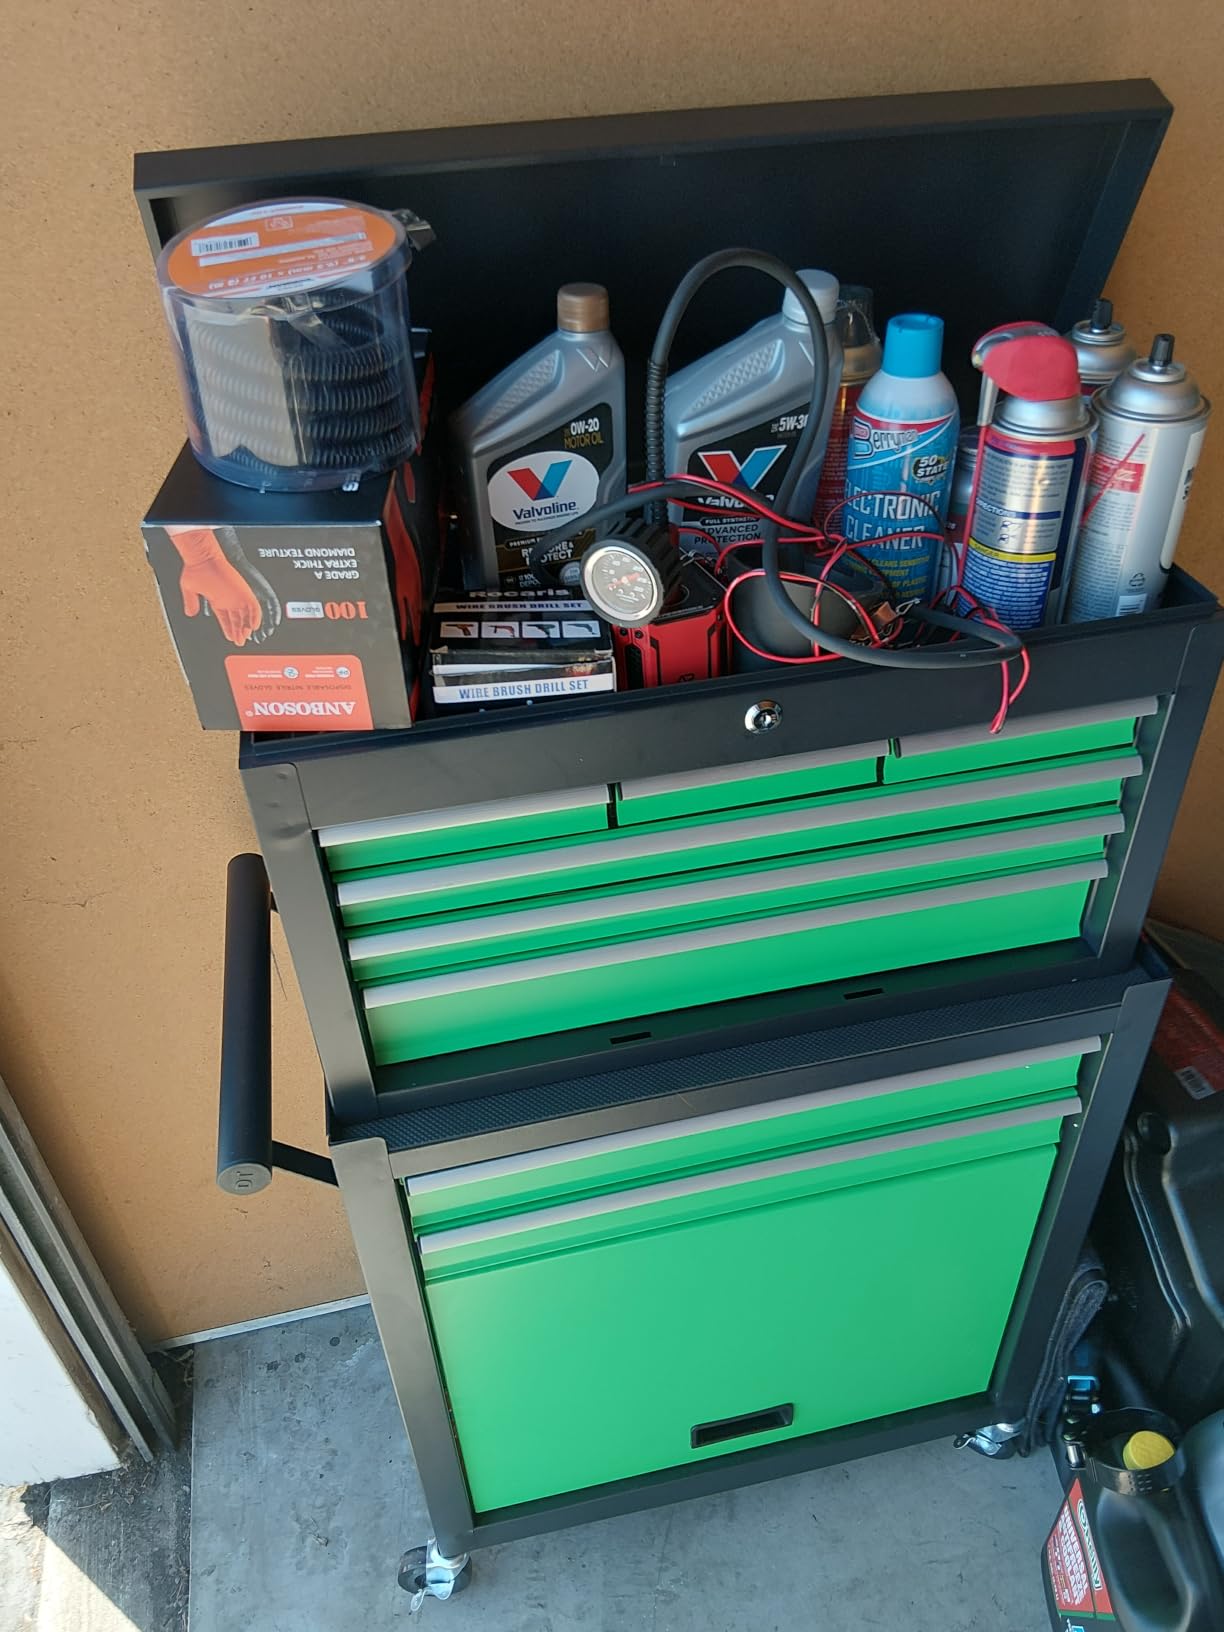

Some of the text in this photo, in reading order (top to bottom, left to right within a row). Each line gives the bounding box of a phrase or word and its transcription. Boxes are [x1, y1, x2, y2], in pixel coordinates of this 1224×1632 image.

[570, 417, 600, 436] 0W-20
[564, 433, 590, 449] MOTOR
[919, 455, 938, 466] 50
[513, 501, 577, 520] Valvoline
[702, 524, 759, 535] DVANCED
[846, 515, 925, 549] CLEANER
[509, 538, 536, 548] PREMIUM
[694, 533, 761, 545] PRTECTION
[258, 547, 356, 558] DIAMOND TEXTURE
[292, 559, 358, 569] EXTRA THICK
[314, 570, 360, 580] GRADE A
[324, 601, 369, 620] 100
[458, 679, 590, 699] WIRE BRUSH DRILL SET
[252, 701, 357, 716] ANBOSON
